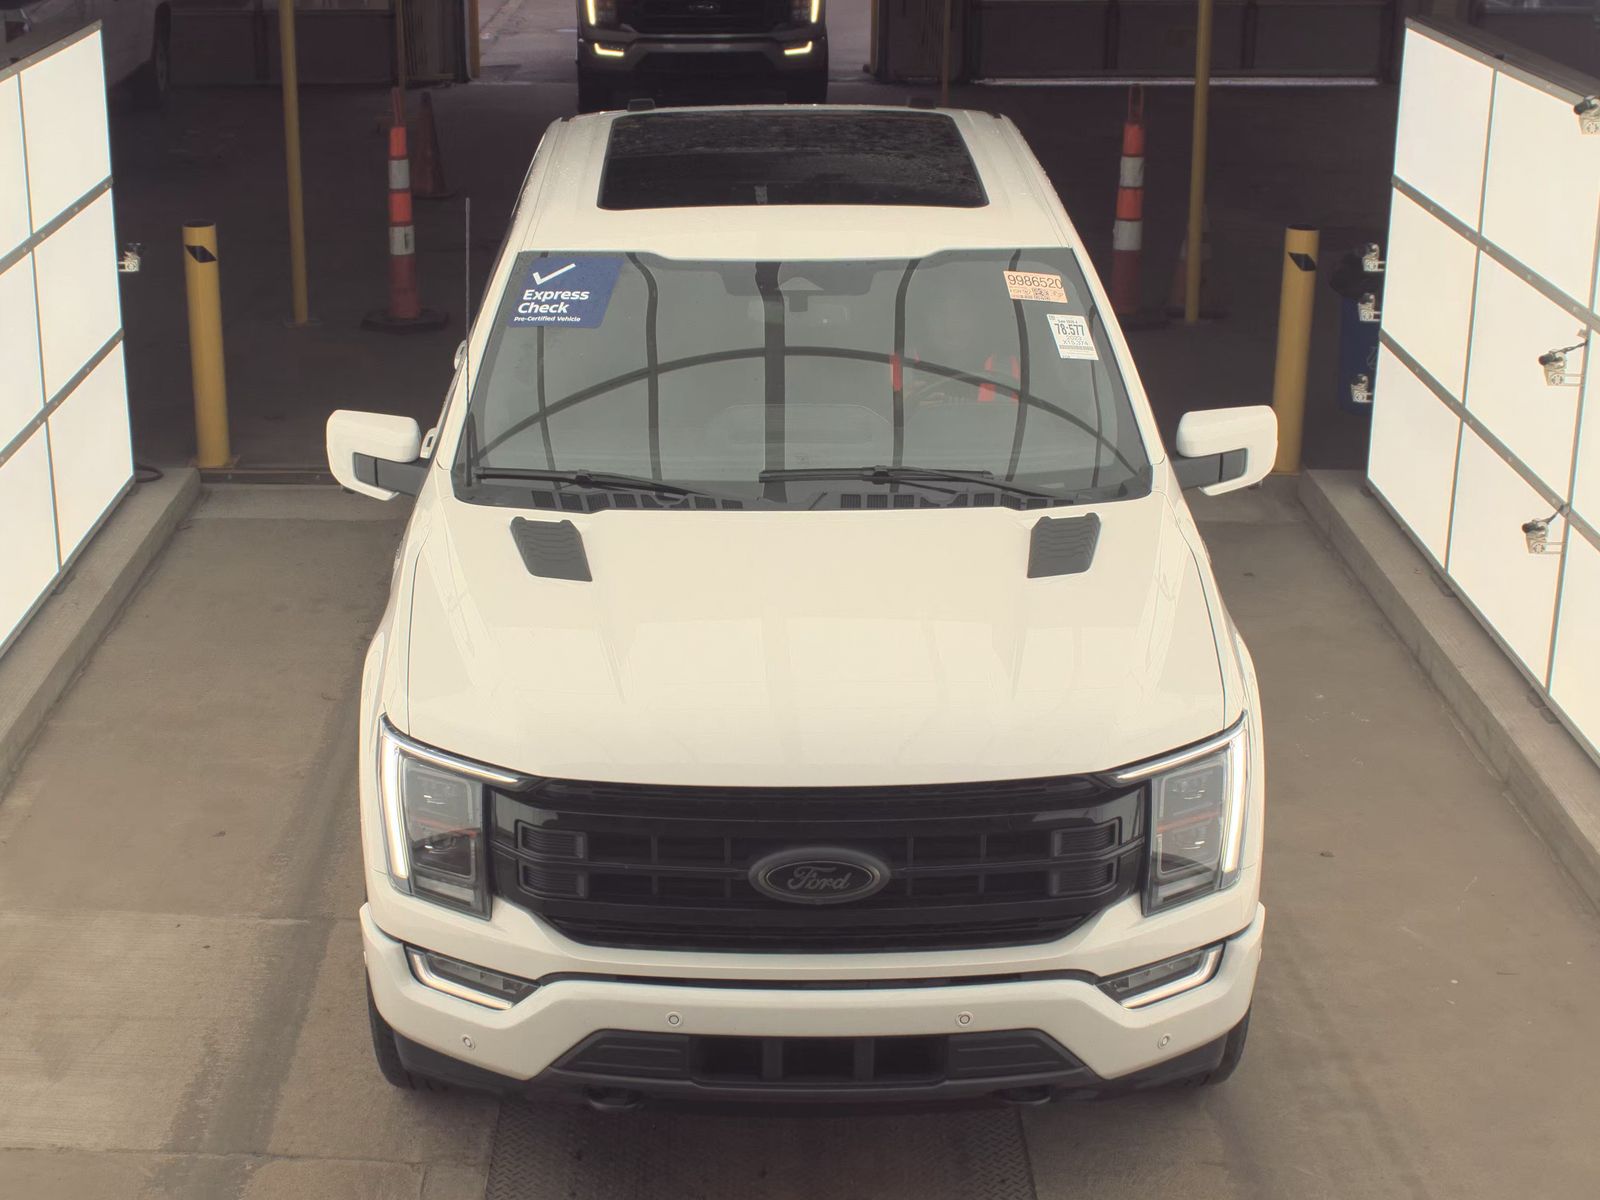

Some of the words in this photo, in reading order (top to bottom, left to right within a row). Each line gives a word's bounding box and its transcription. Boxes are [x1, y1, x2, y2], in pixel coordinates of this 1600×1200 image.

[1007, 274, 1063, 290] 9986520
[522, 289, 590, 302] Express
[518, 302, 570, 314] Check
[787, 865, 852, 890] Ford
